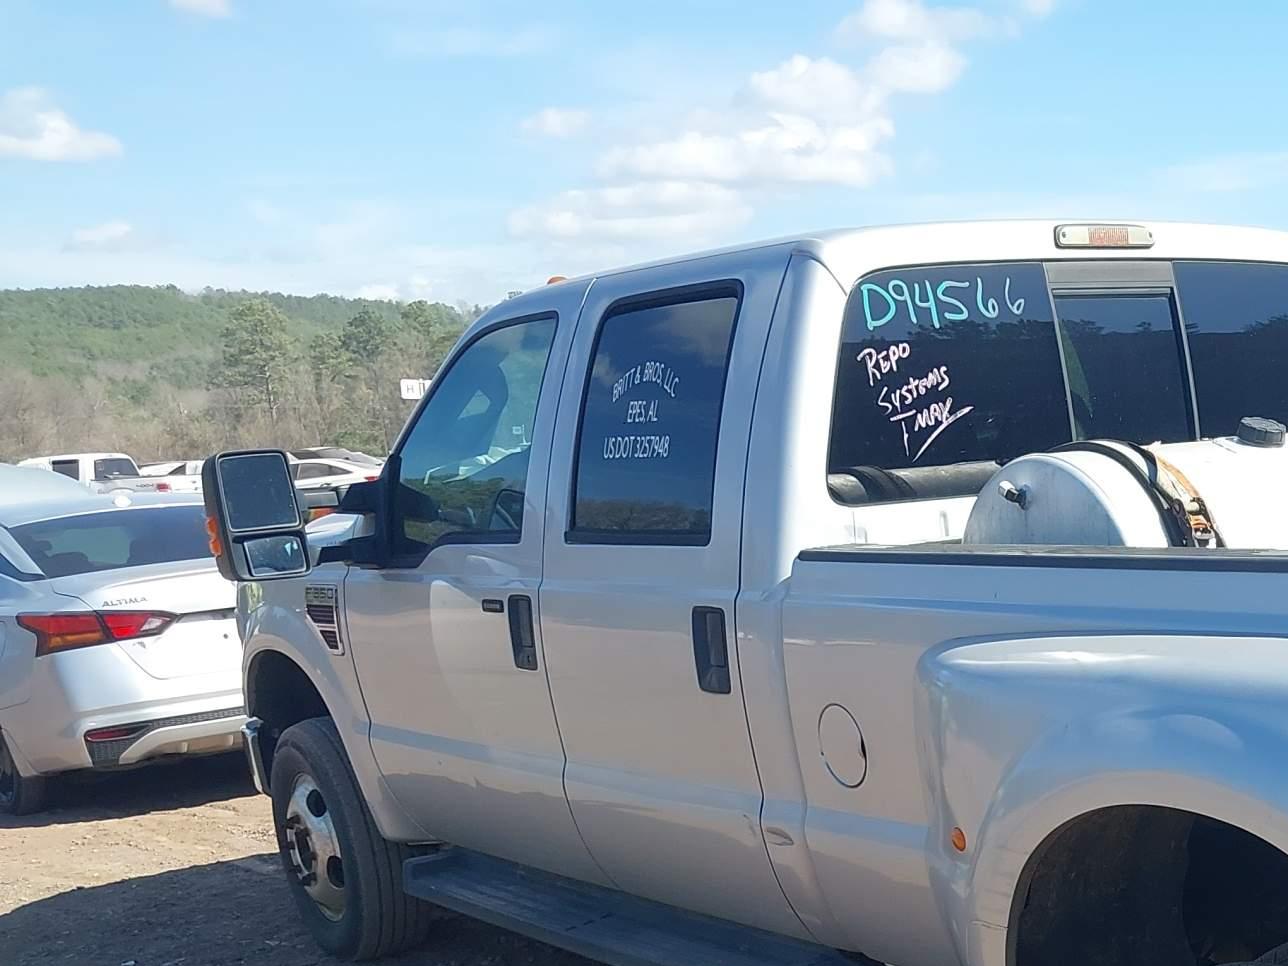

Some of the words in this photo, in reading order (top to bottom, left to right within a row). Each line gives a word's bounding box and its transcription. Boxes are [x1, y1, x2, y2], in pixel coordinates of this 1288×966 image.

[861, 276, 1025, 331] D94566
[612, 367, 636, 403] BRITT
[663, 367, 680, 398] LLC
[627, 400, 647, 424] EPES,
[646, 400, 659, 422] AL
[634, 435, 670, 458] 3257948
[102, 597, 148, 608] ALTIMA
